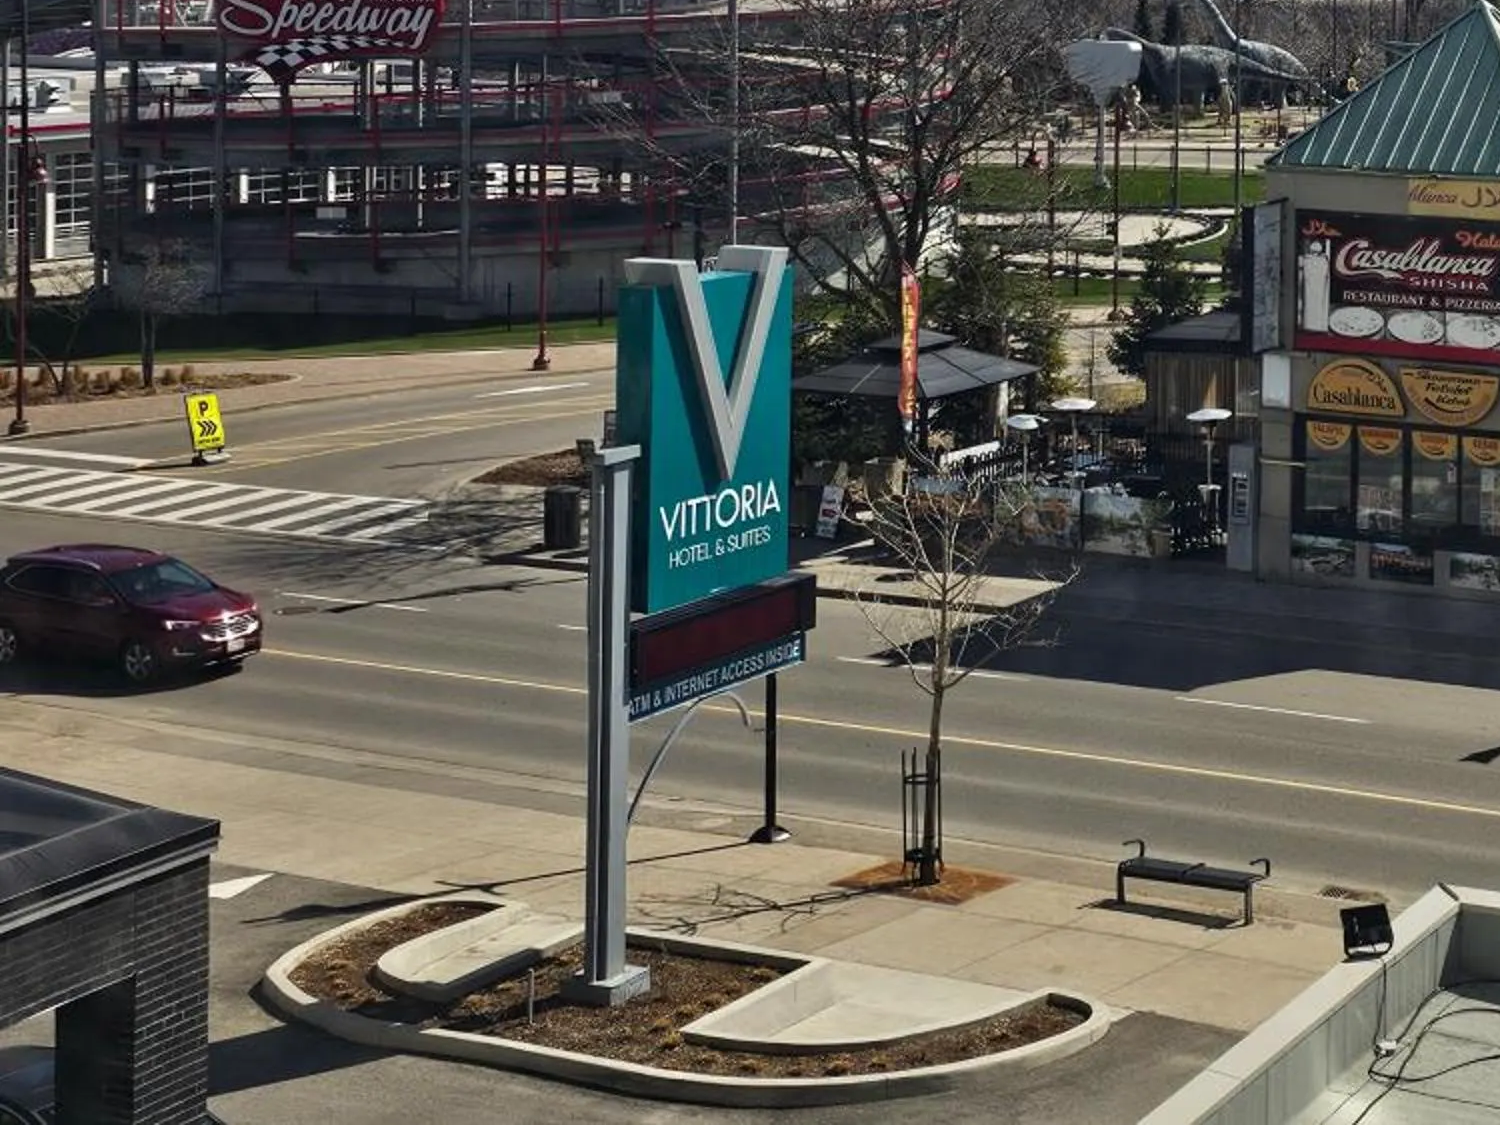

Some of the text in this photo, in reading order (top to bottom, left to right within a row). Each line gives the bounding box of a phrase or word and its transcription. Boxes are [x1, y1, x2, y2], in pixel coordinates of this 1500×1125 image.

[1336, 237, 1498, 280] Casablanca
[1343, 291, 1429, 307] RESTAURANT
[1430, 298, 1440, 307] &
[1408, 276, 1489, 291] SHISHA
[199, 401, 208, 416] P
[1313, 382, 1395, 410] Casablanca
[660, 477, 781, 542] VITTORIA
[669, 525, 771, 569] HOTEL & SUITES
[629, 640, 800, 716] ATM & INTERNET ACCESS INSIDE
